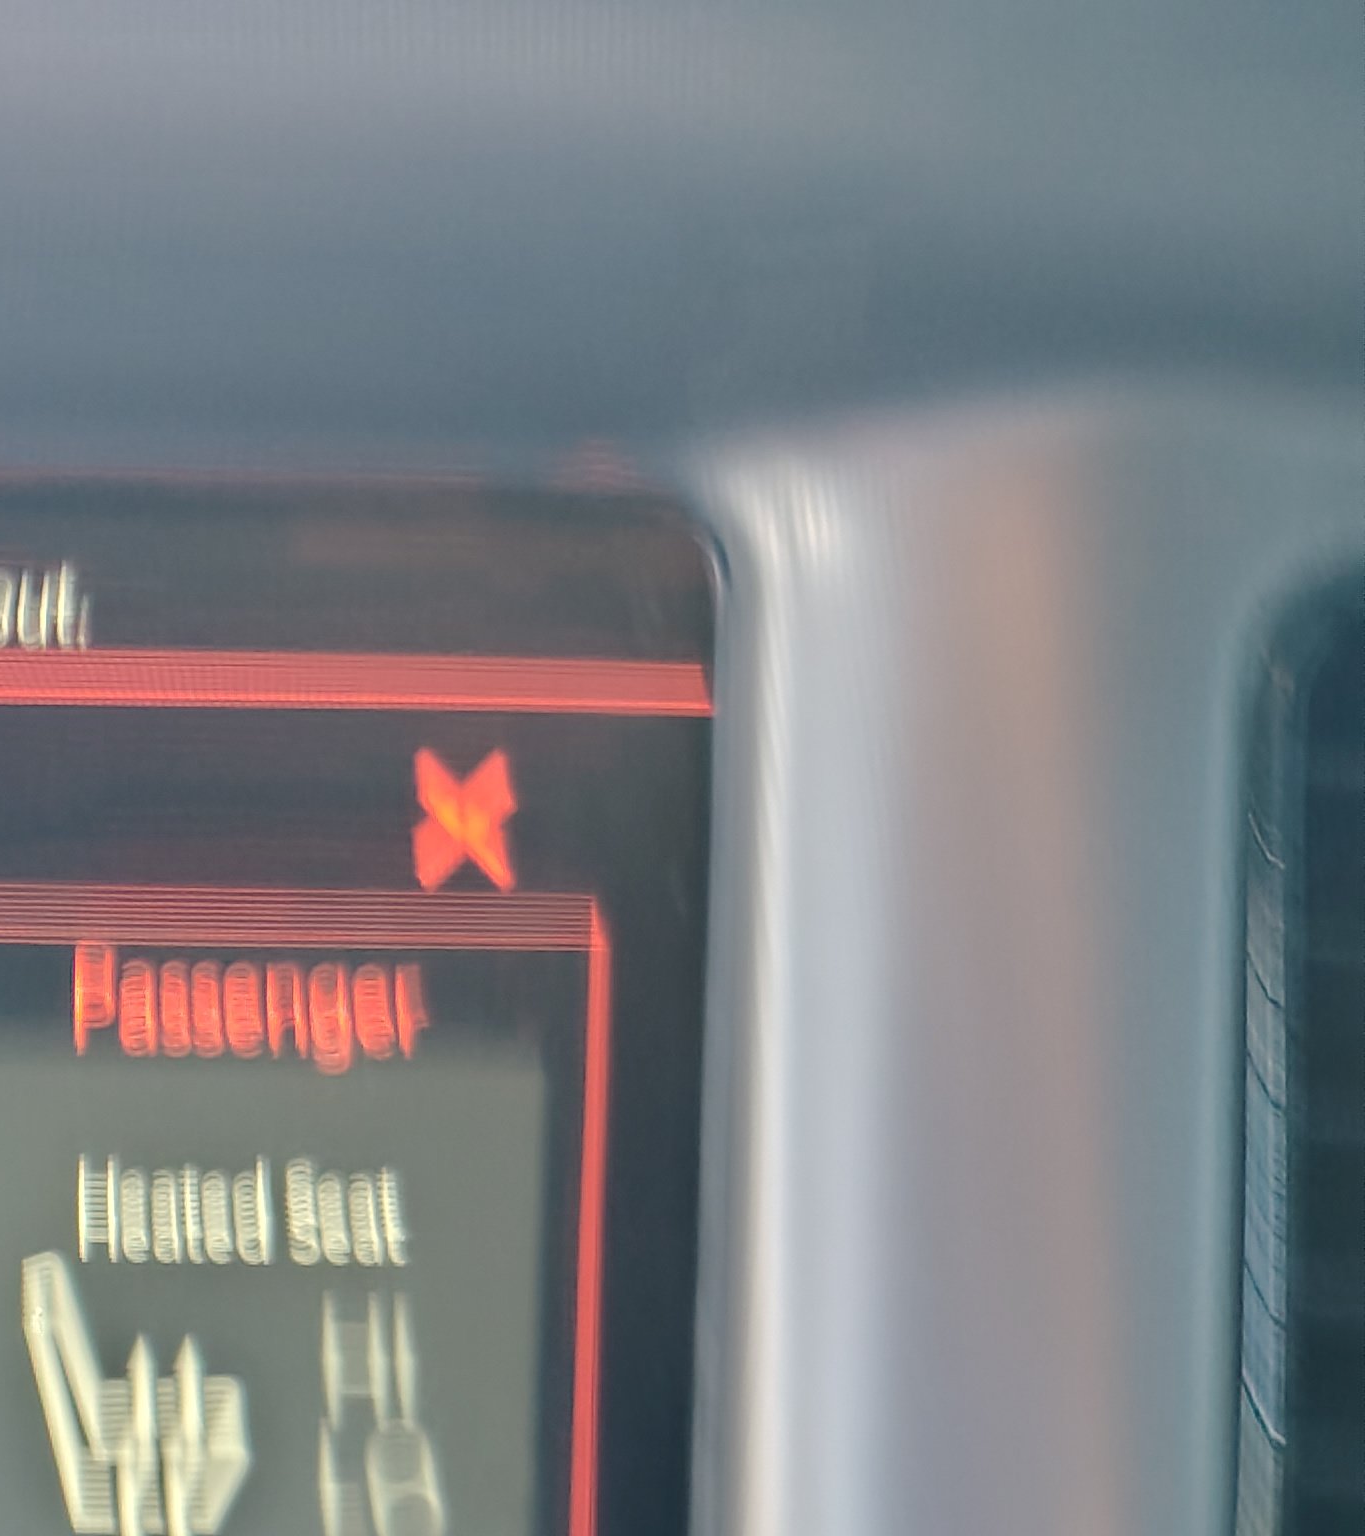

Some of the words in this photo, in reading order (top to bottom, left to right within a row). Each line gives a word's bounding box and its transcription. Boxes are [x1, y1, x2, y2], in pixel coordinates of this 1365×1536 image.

[72, 942, 429, 1076] Passenger
[76, 1153, 273, 1265] Heated
[284, 1155, 409, 1267] Seat
